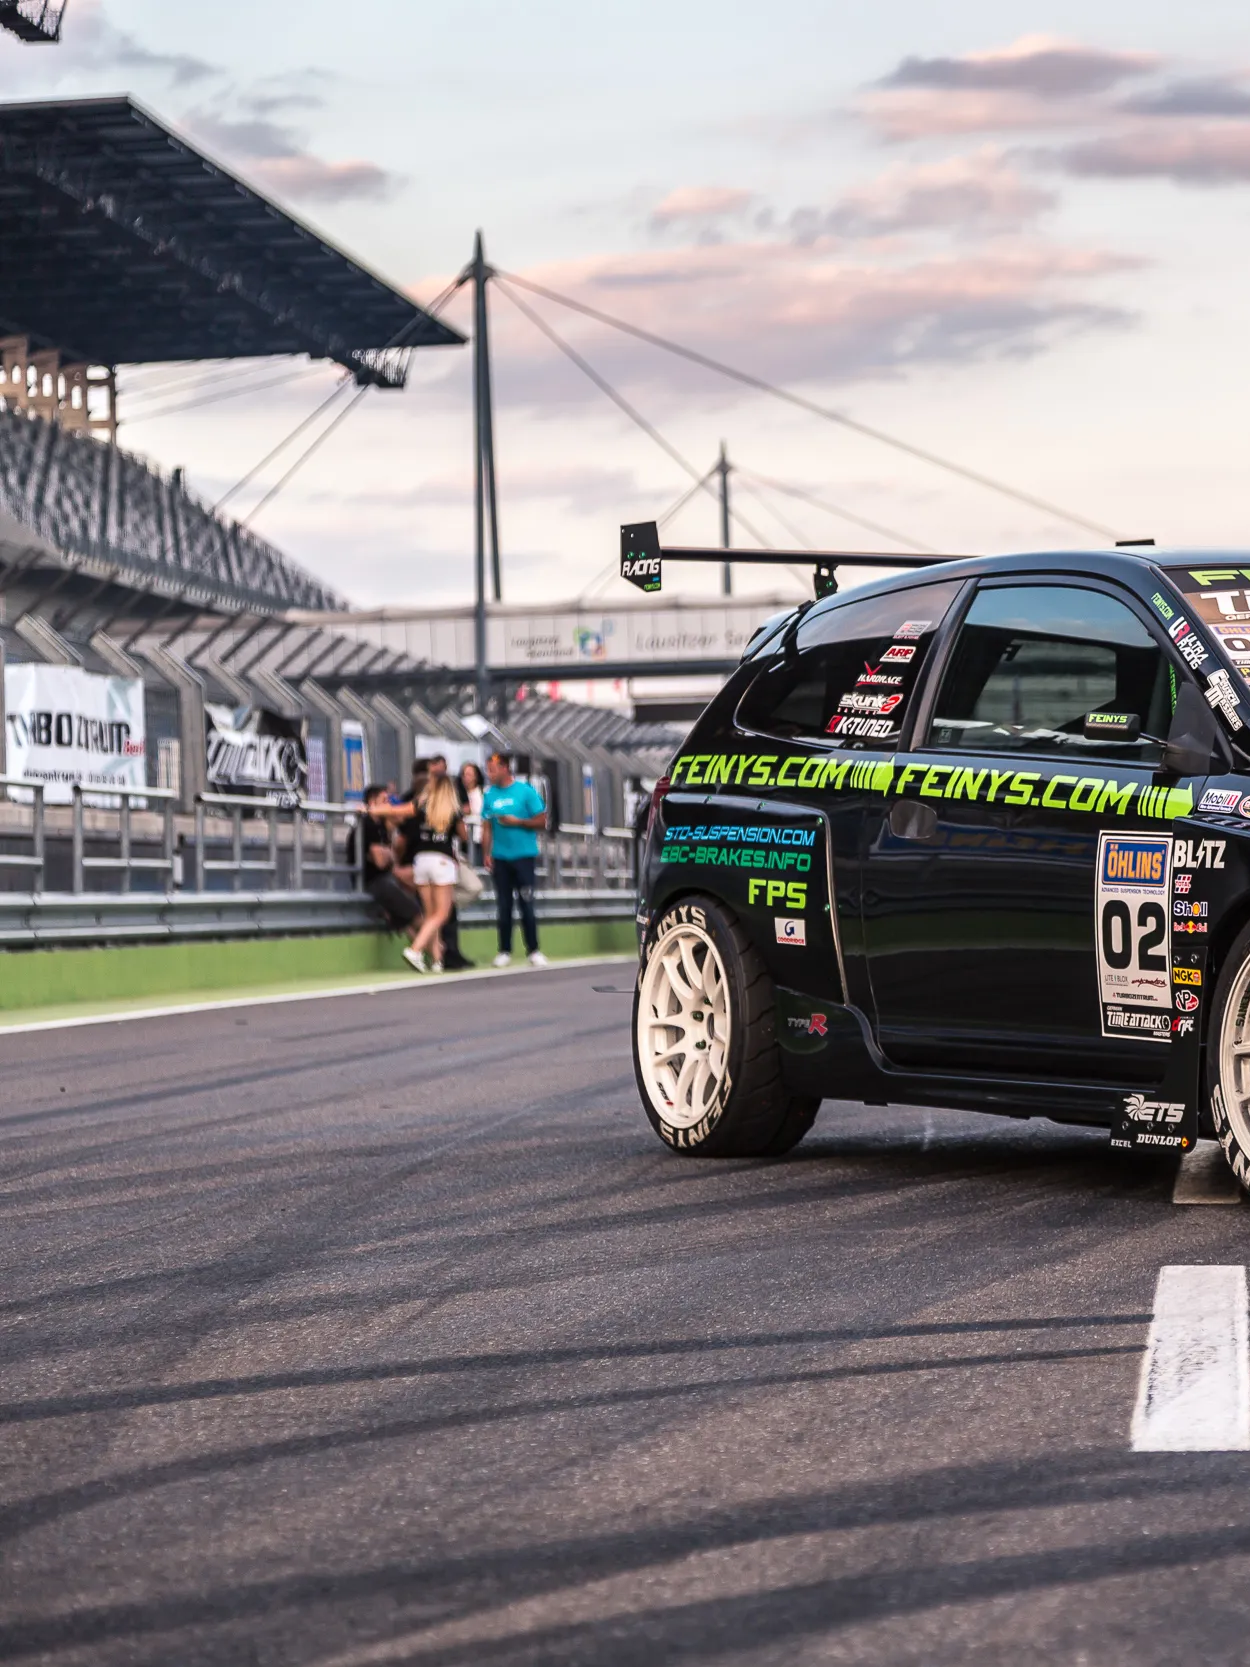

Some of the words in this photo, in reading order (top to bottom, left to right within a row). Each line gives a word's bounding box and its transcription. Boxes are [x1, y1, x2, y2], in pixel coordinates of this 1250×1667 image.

[622, 558, 661, 577] RACING
[886, 648, 914, 657] ARP
[1176, 638, 1202, 671] RACING
[1186, 632, 1209, 666] ULTRA
[1207, 670, 1240, 706] CLUTCH
[1088, 713, 1128, 723] FEINYS
[670, 754, 853, 790] FEINYS.COM
[895, 762, 1138, 815] FEINYS.COM
[1203, 792, 1231, 805] Mobil
[660, 846, 811, 872] EBC-BRAKES.INFO
[1107, 843, 1164, 880] ÖHLINS
[748, 878, 808, 909] FPS
[1102, 899, 1167, 972] 02
[1174, 970, 1193, 982] NGK
[807, 1013, 829, 1037] R
[1110, 1138, 1132, 1148] EXCEL
[1136, 1133, 1182, 1147] DUNLOP
